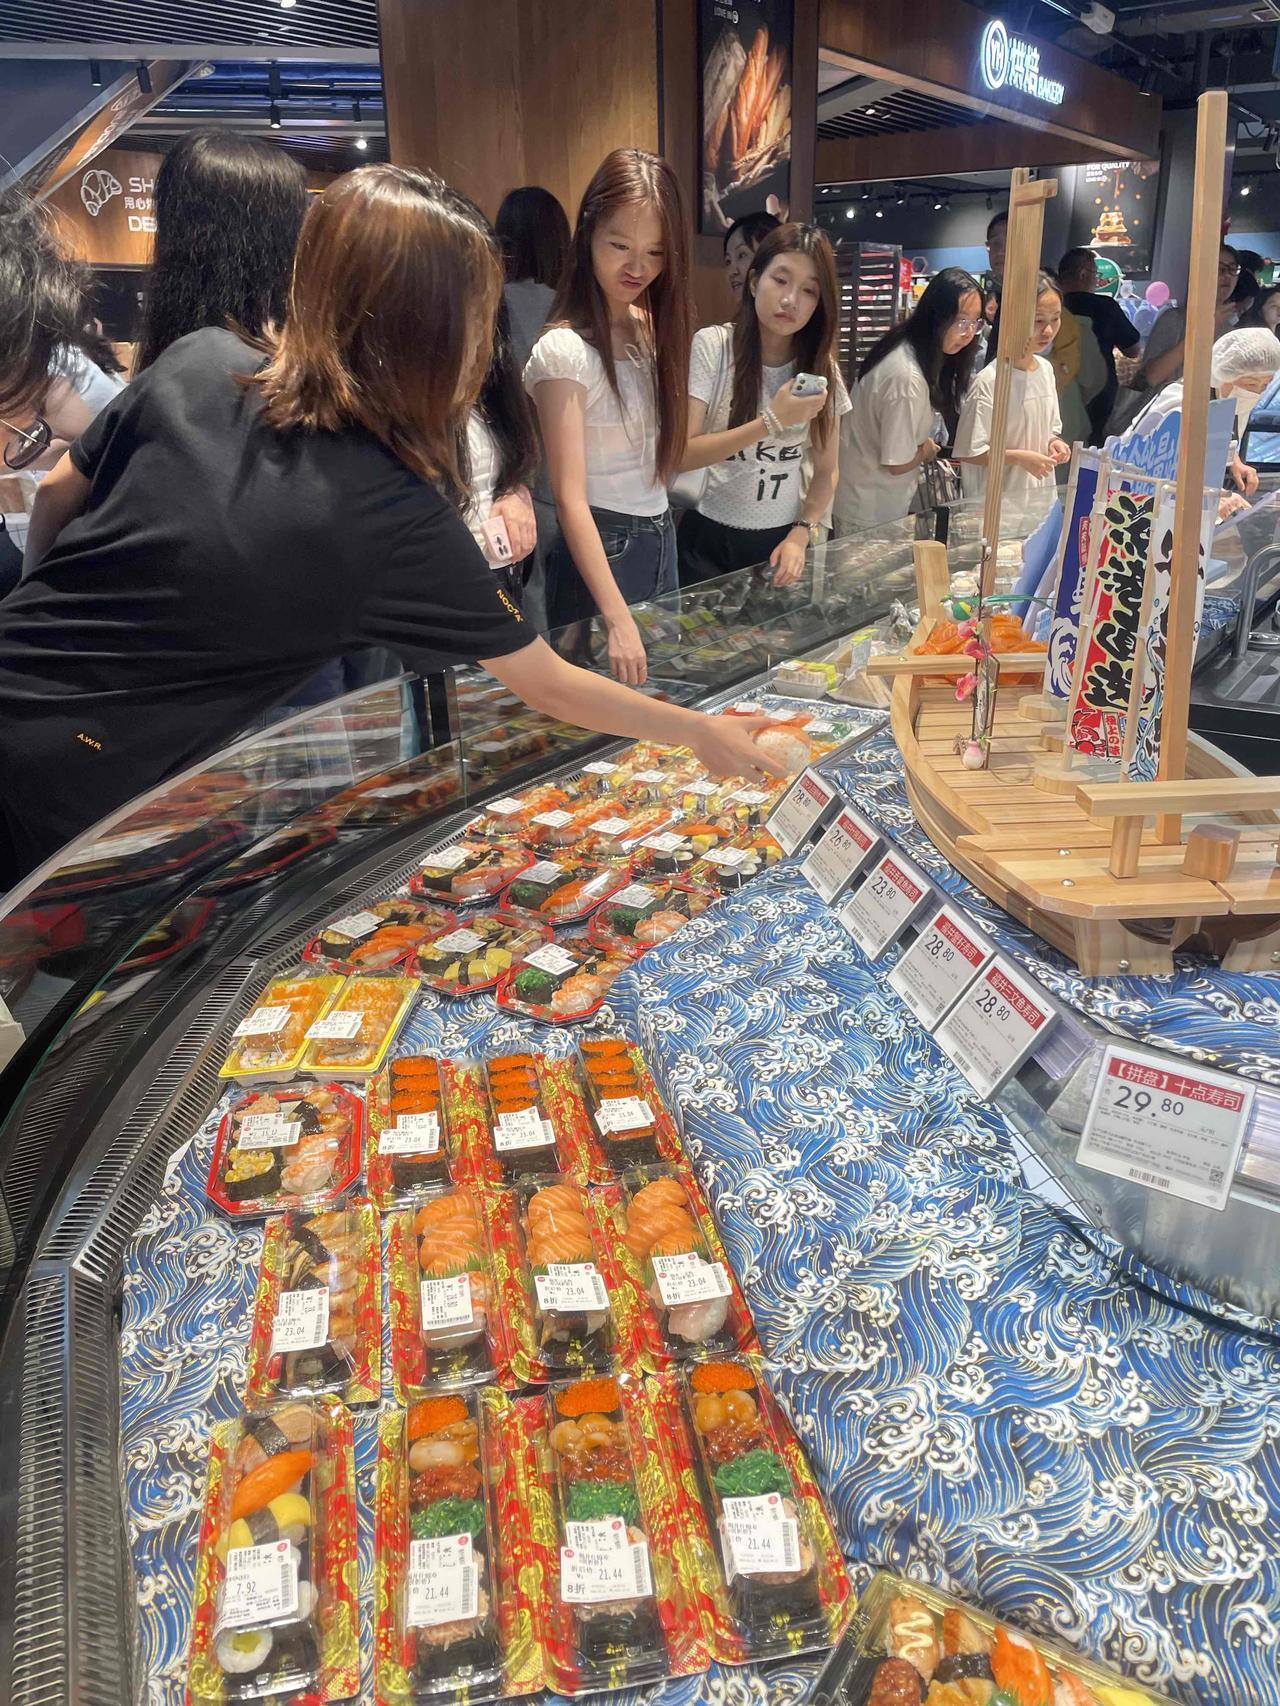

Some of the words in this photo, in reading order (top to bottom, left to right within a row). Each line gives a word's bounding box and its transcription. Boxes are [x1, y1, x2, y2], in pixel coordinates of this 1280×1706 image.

[1038, 76, 1064, 104] BAKERY
[1101, 161, 1130, 171] QUALITY
[829, 829, 852, 851] 26.80
[871, 876, 897, 900] 23.80
[924, 934, 955, 962] 28.80
[975, 989, 1011, 1022] 28.80
[990, 974, 1041, 1026] 福井三文鱼寿司
[1117, 1062, 1242, 1111] 【拼盘】十点寿司
[1113, 1085, 1184, 1118] 29.80
[748, 1537, 771, 1550] 21.44
[599, 1568, 623, 1581] 21.44
[236, 1580, 256, 1595] 7.92
[425, 1585, 449, 1600] 21.44
[567, 1583, 586, 1595] 8折
